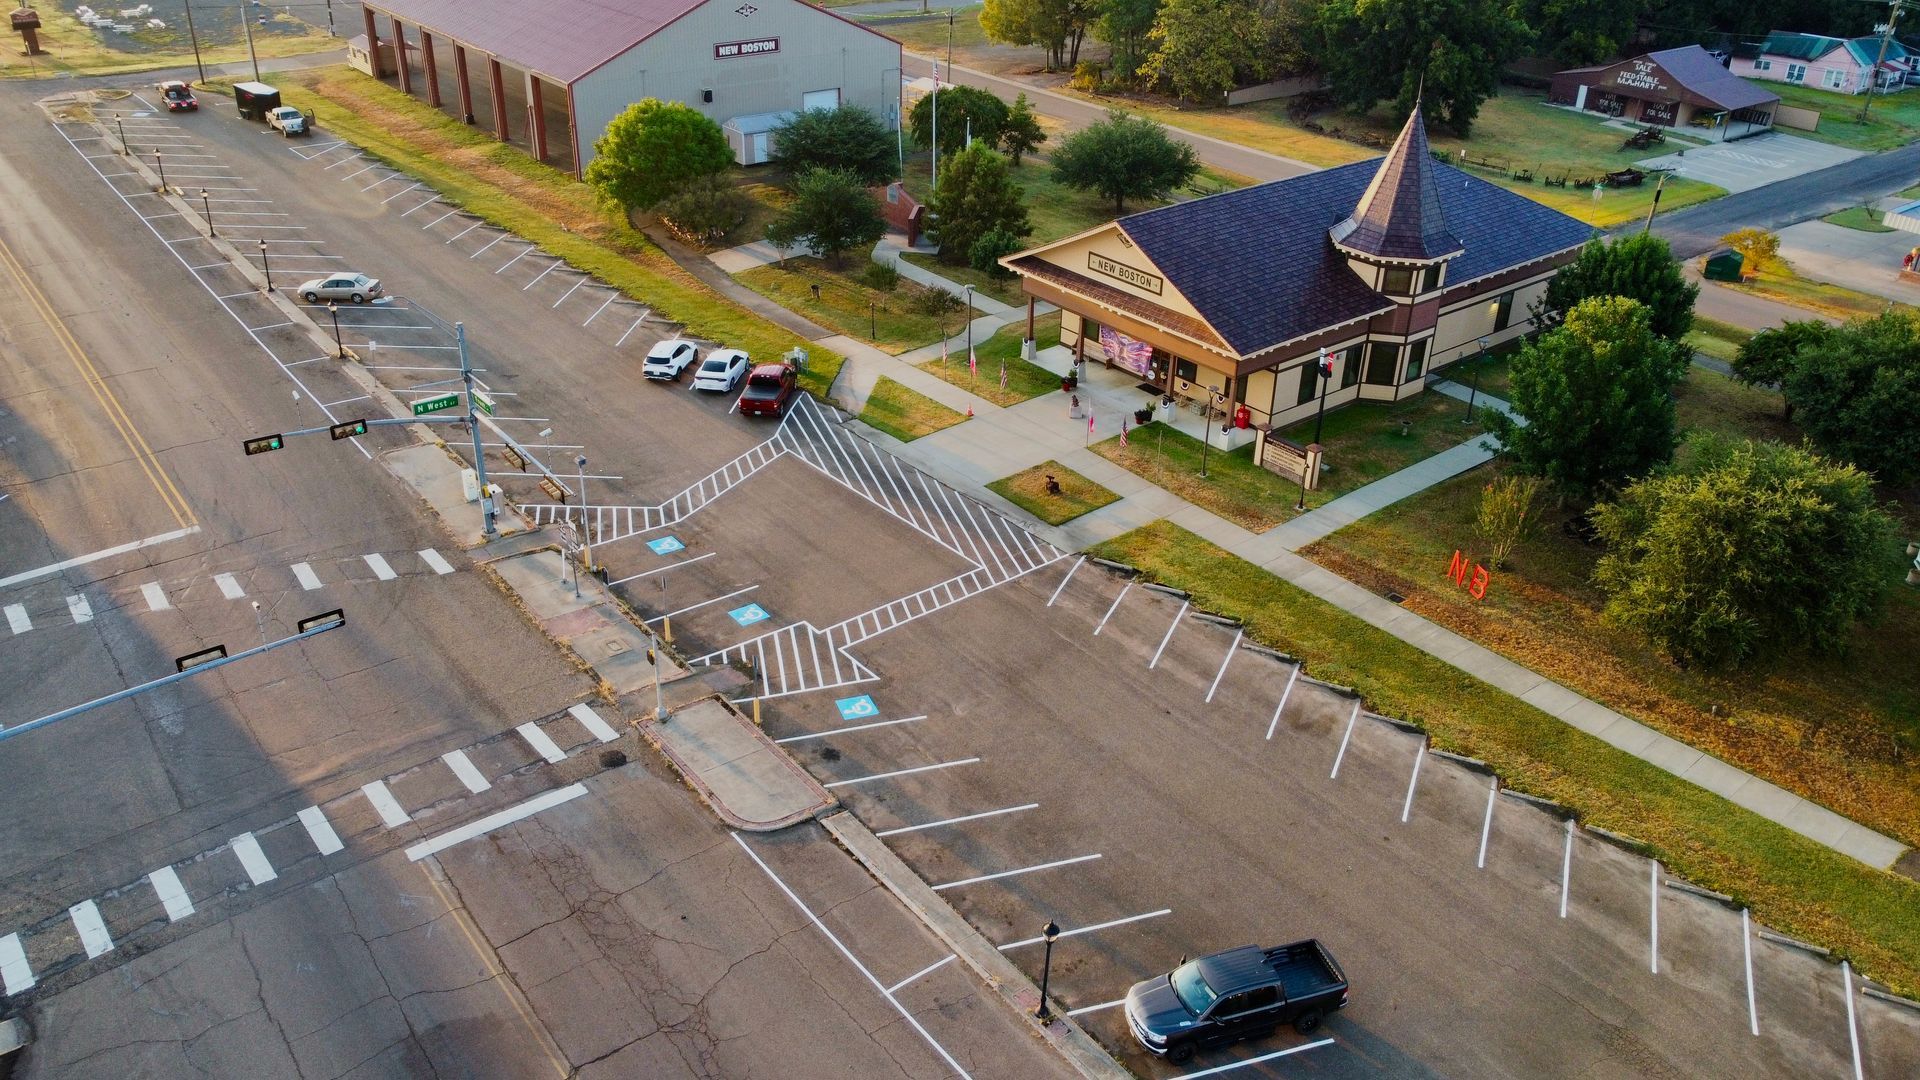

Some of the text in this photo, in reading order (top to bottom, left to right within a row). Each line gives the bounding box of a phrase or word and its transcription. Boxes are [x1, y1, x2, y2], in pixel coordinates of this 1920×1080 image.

[719, 41, 775, 56] NEW BOSTON
[1635, 64, 1652, 72] SALE
[1658, 111, 1672, 119] SALE
[1098, 260, 1152, 288] NEW BOSTON
[417, 404, 424, 413] N
[427, 399, 447, 411] West
[1447, 549, 1489, 600] NB
